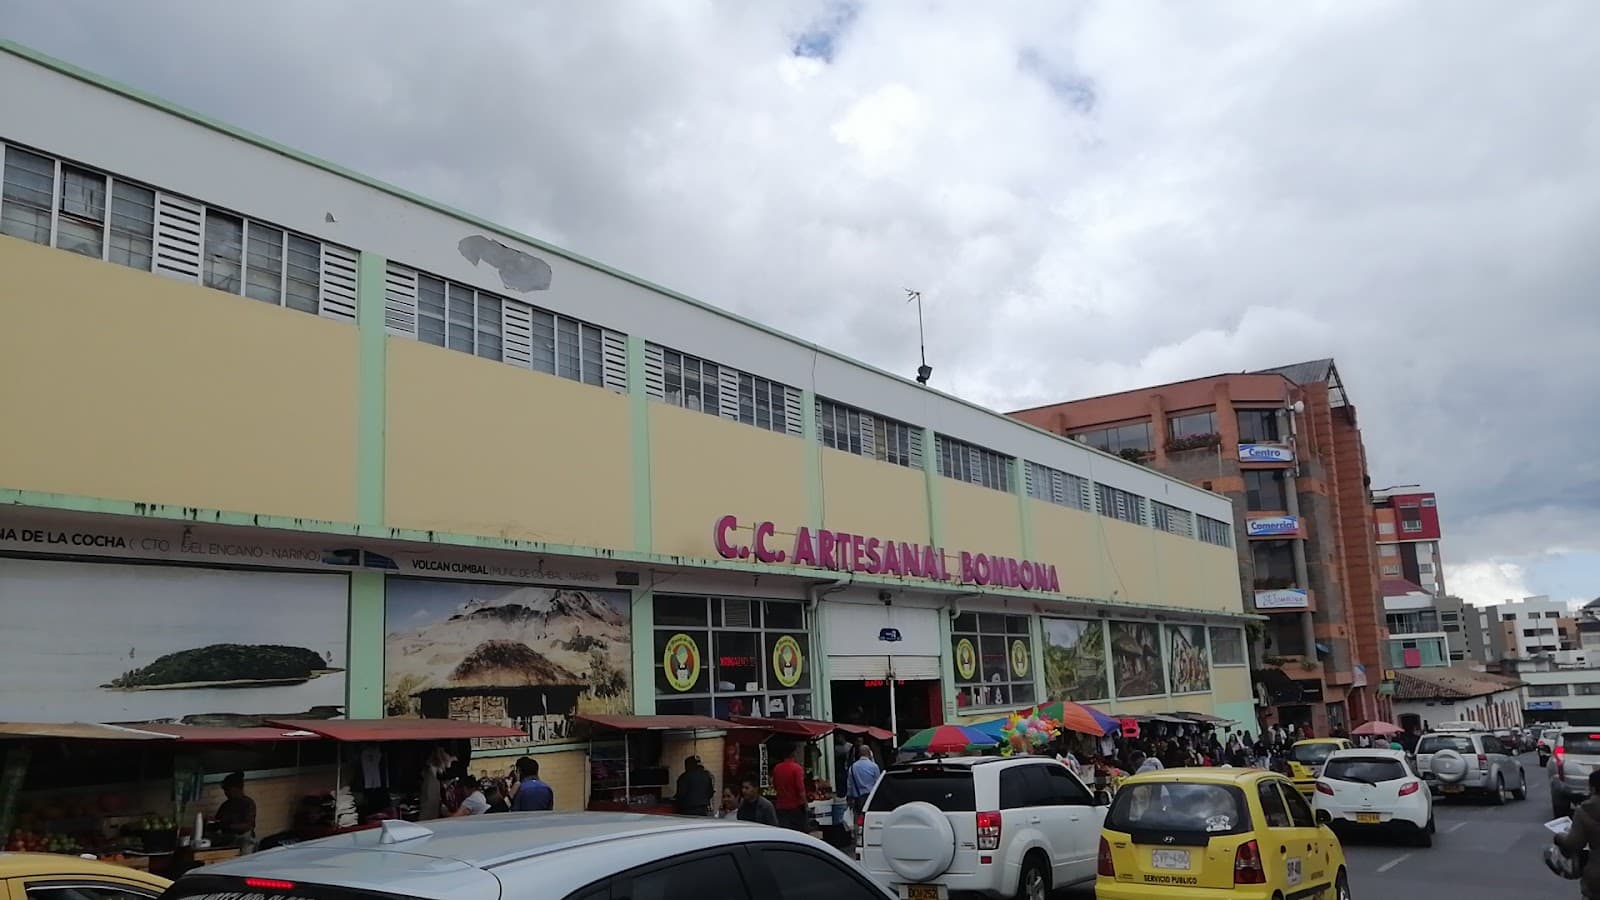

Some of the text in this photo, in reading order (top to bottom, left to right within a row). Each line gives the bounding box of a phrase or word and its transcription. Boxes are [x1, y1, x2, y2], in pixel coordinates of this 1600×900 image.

[1248, 449, 1280, 457] Centro
[1251, 520, 1295, 530] Comercial
[22, 530, 44, 542] DE
[48, 533, 67, 544] LA
[72, 533, 126, 548] COCHA
[791, 527, 950, 580] ARTESANAL
[960, 551, 1060, 592] BOMBONA
[412, 559, 450, 572] VOLCAN
[452, 562, 489, 575] CUMBAL
[1144, 874, 1170, 883] SERVICIO
[1172, 876, 1197, 885] PUBLICO
